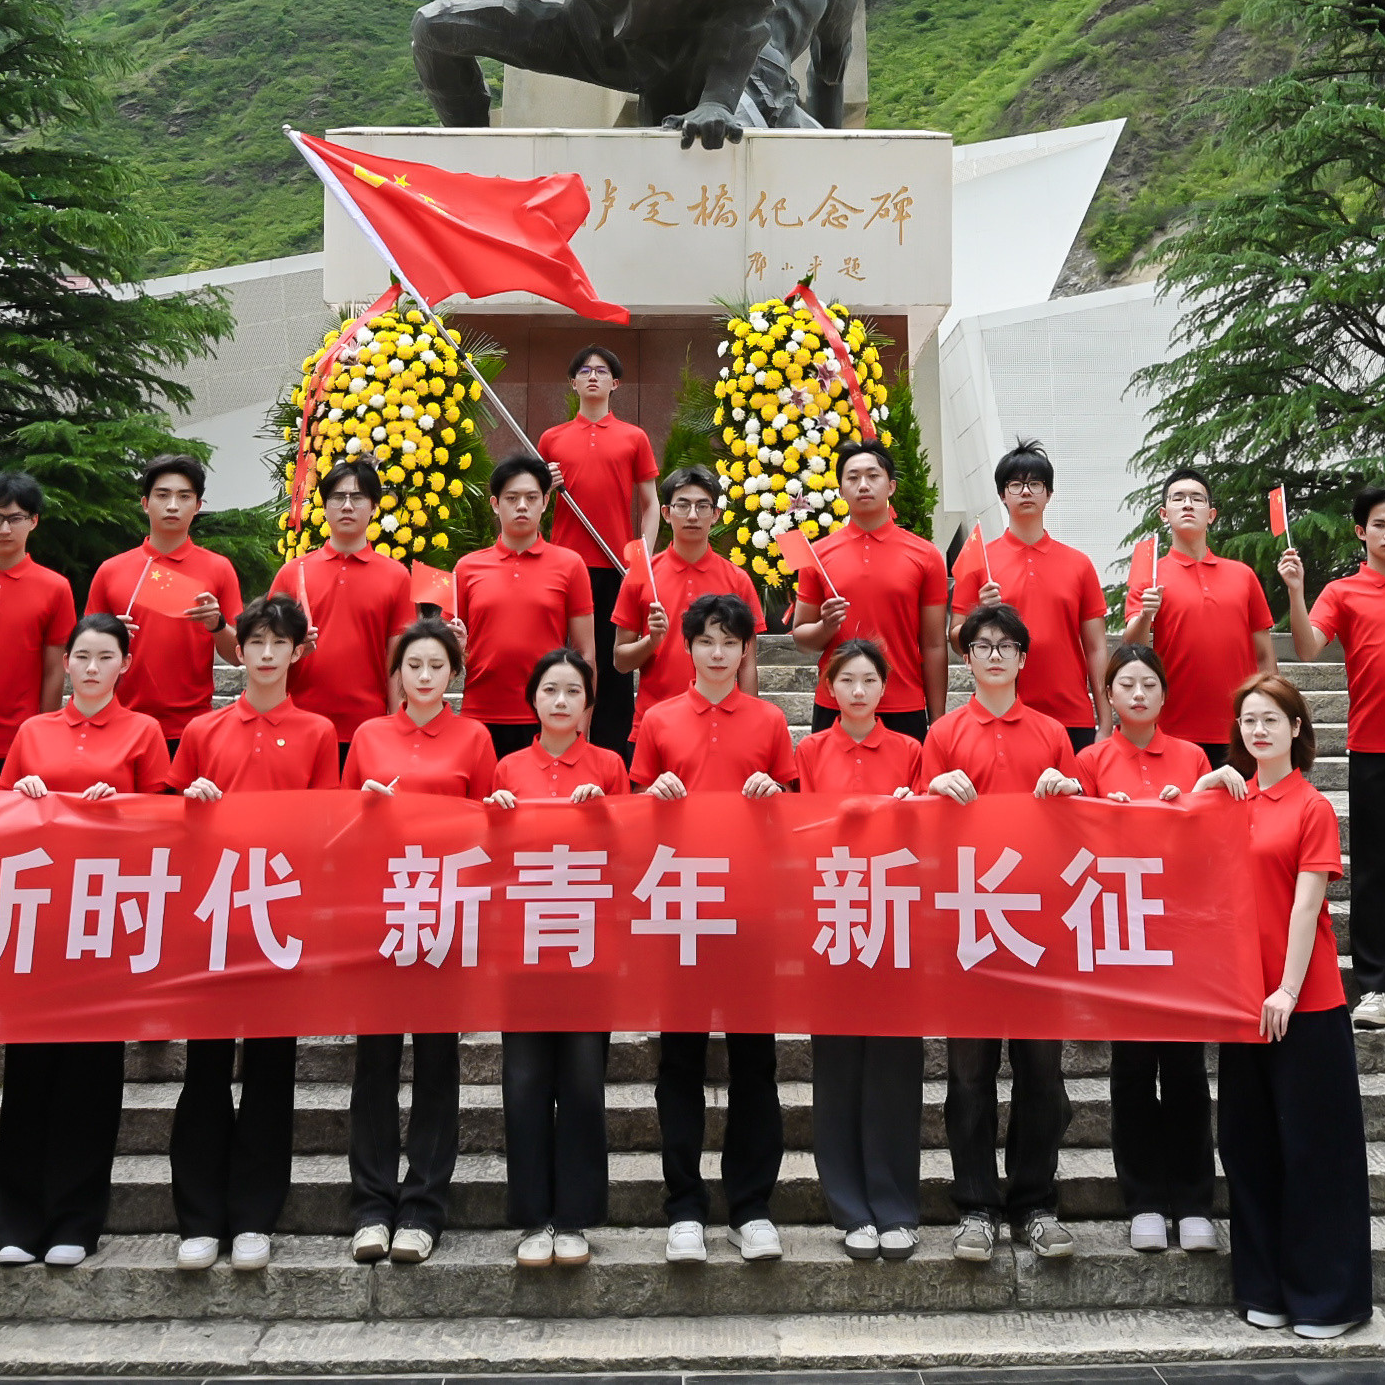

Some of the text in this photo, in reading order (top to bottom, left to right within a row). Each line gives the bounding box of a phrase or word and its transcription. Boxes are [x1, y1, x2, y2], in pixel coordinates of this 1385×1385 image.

[377, 843, 738, 969] 新青年
[812, 844, 1175, 973] 新长征
